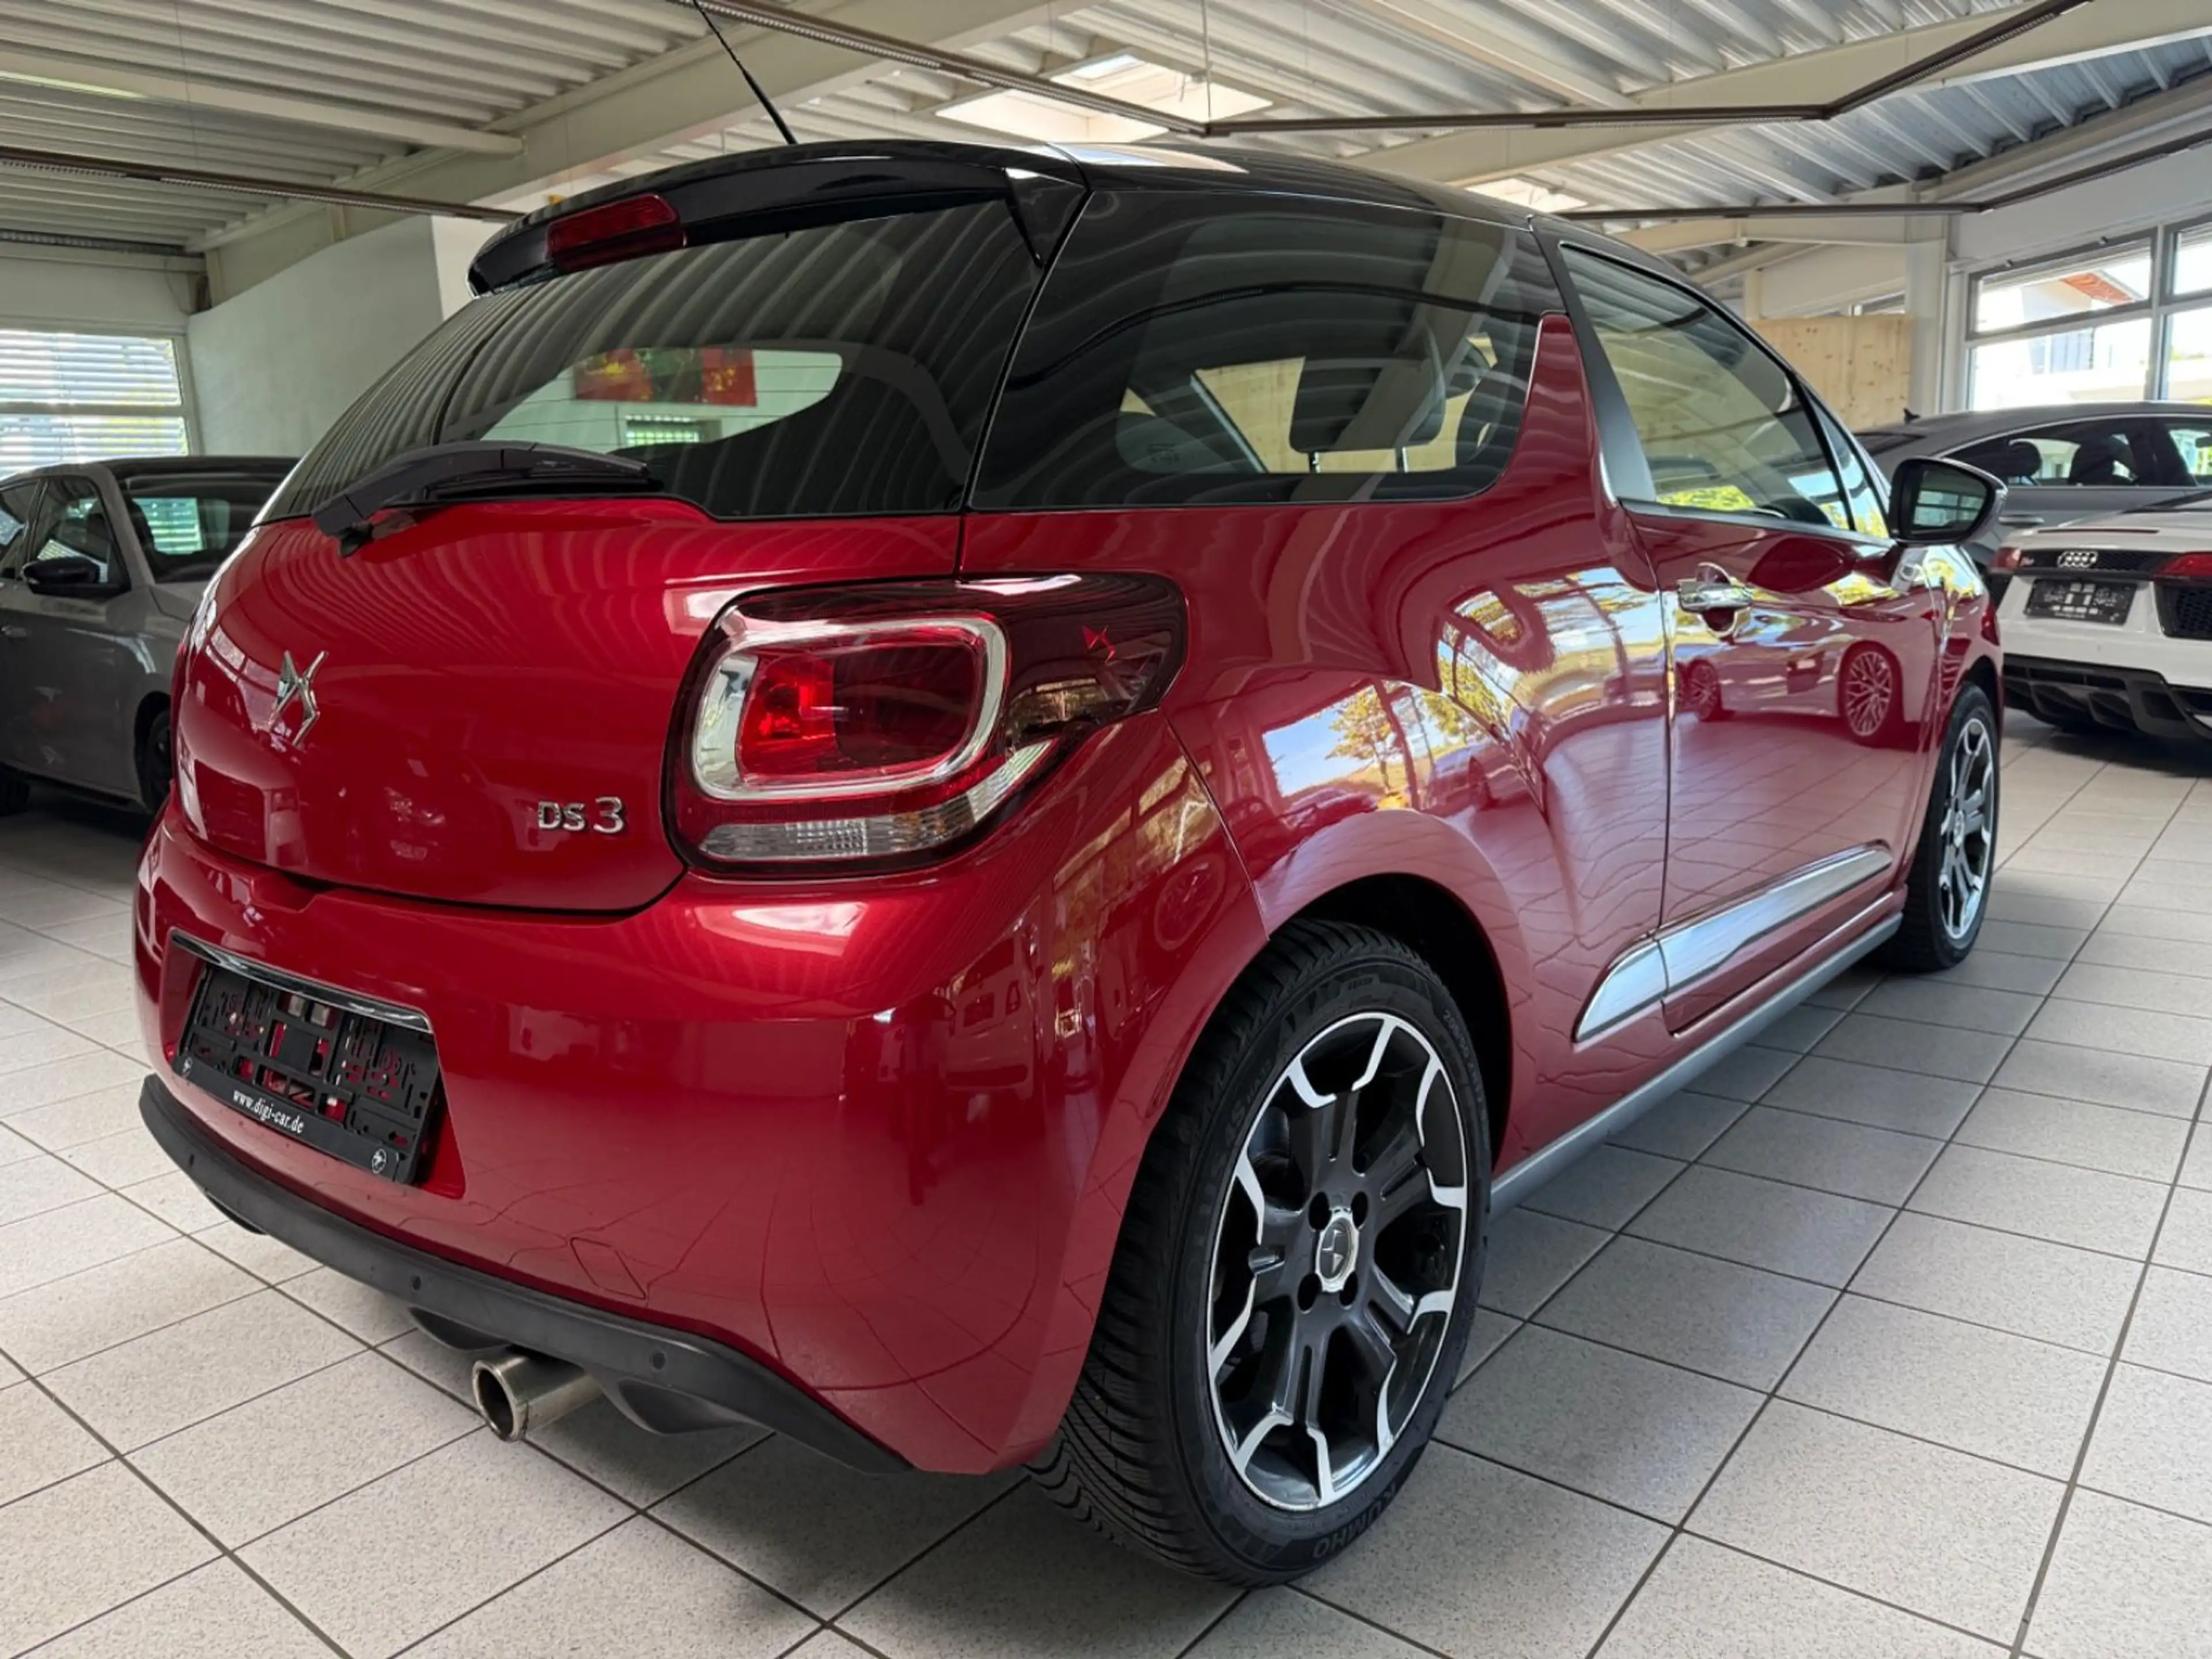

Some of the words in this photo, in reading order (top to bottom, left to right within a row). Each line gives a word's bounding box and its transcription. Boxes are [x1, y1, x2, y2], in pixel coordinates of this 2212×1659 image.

[537, 800, 586, 831] DS
[593, 796, 624, 834] 3
[232, 1090, 305, 1134] www.digi-car.de
[1312, 1481, 1397, 1559] KUMHO
